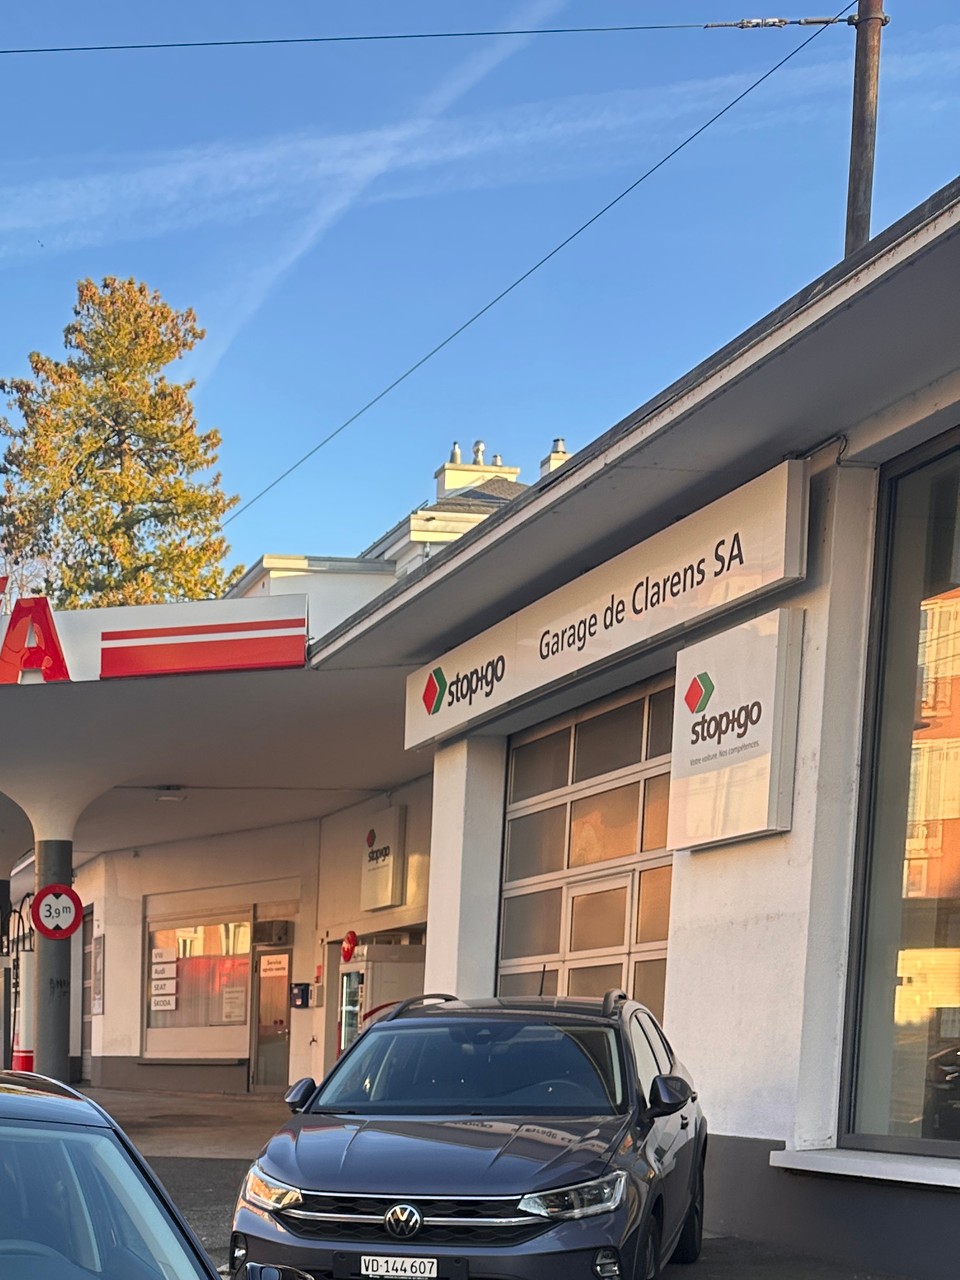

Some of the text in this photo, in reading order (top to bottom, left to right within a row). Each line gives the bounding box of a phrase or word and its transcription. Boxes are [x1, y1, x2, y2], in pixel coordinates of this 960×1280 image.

[539, 532, 744, 660] Garage de Clarens SA
[447, 654, 506, 707] stop+go
[690, 700, 762, 745] stop+go
[154, 967, 166, 975] Audi
[154, 983, 167, 991] SEAT
